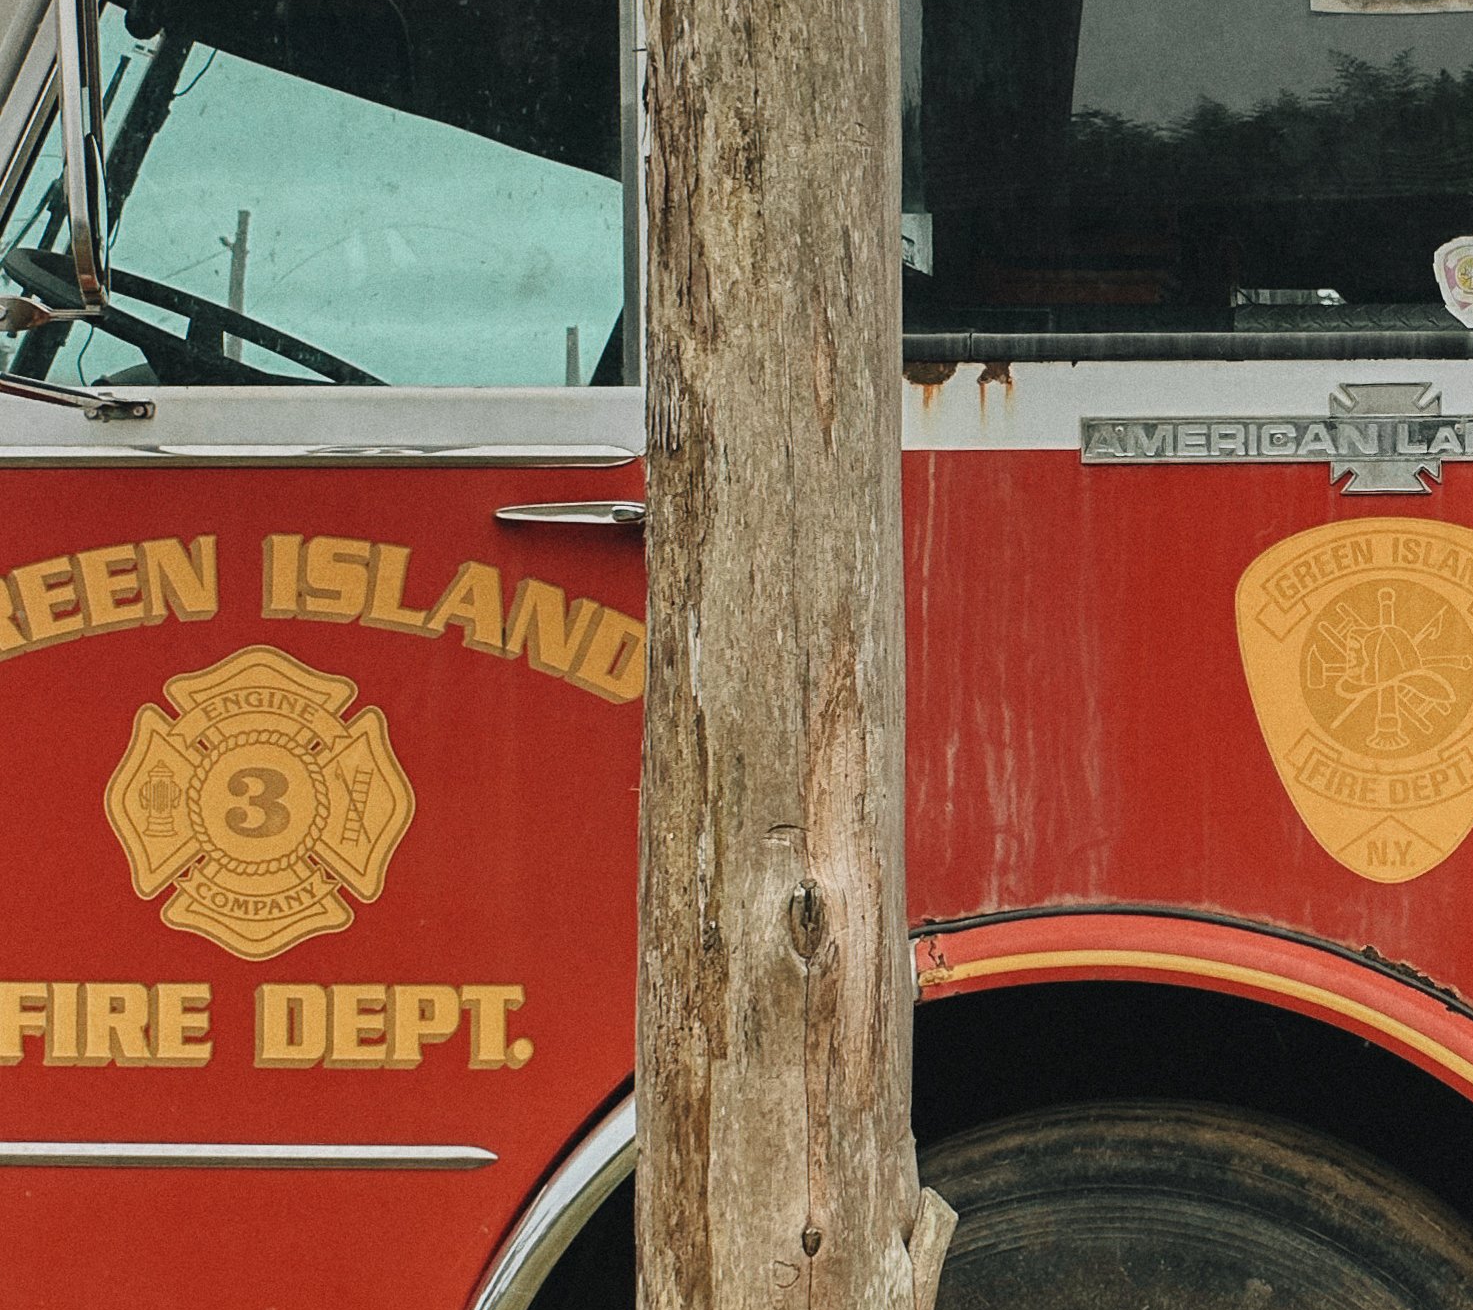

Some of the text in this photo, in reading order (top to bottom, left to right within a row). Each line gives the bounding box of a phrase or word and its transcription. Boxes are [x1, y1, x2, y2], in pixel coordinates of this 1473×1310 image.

[1084, 421, 1379, 458] AMERICAN
[1275, 538, 1373, 601] GREEN
[262, 533, 646, 704] ISLAND
[201, 691, 320, 725] ENGINE
[224, 766, 292, 839] 3
[1306, 757, 1379, 804] FIRE
[1366, 839, 1417, 867] N.Y.
[195, 881, 318, 916] COMPANY
[0, 982, 534, 1069] FIRE DEPT.
